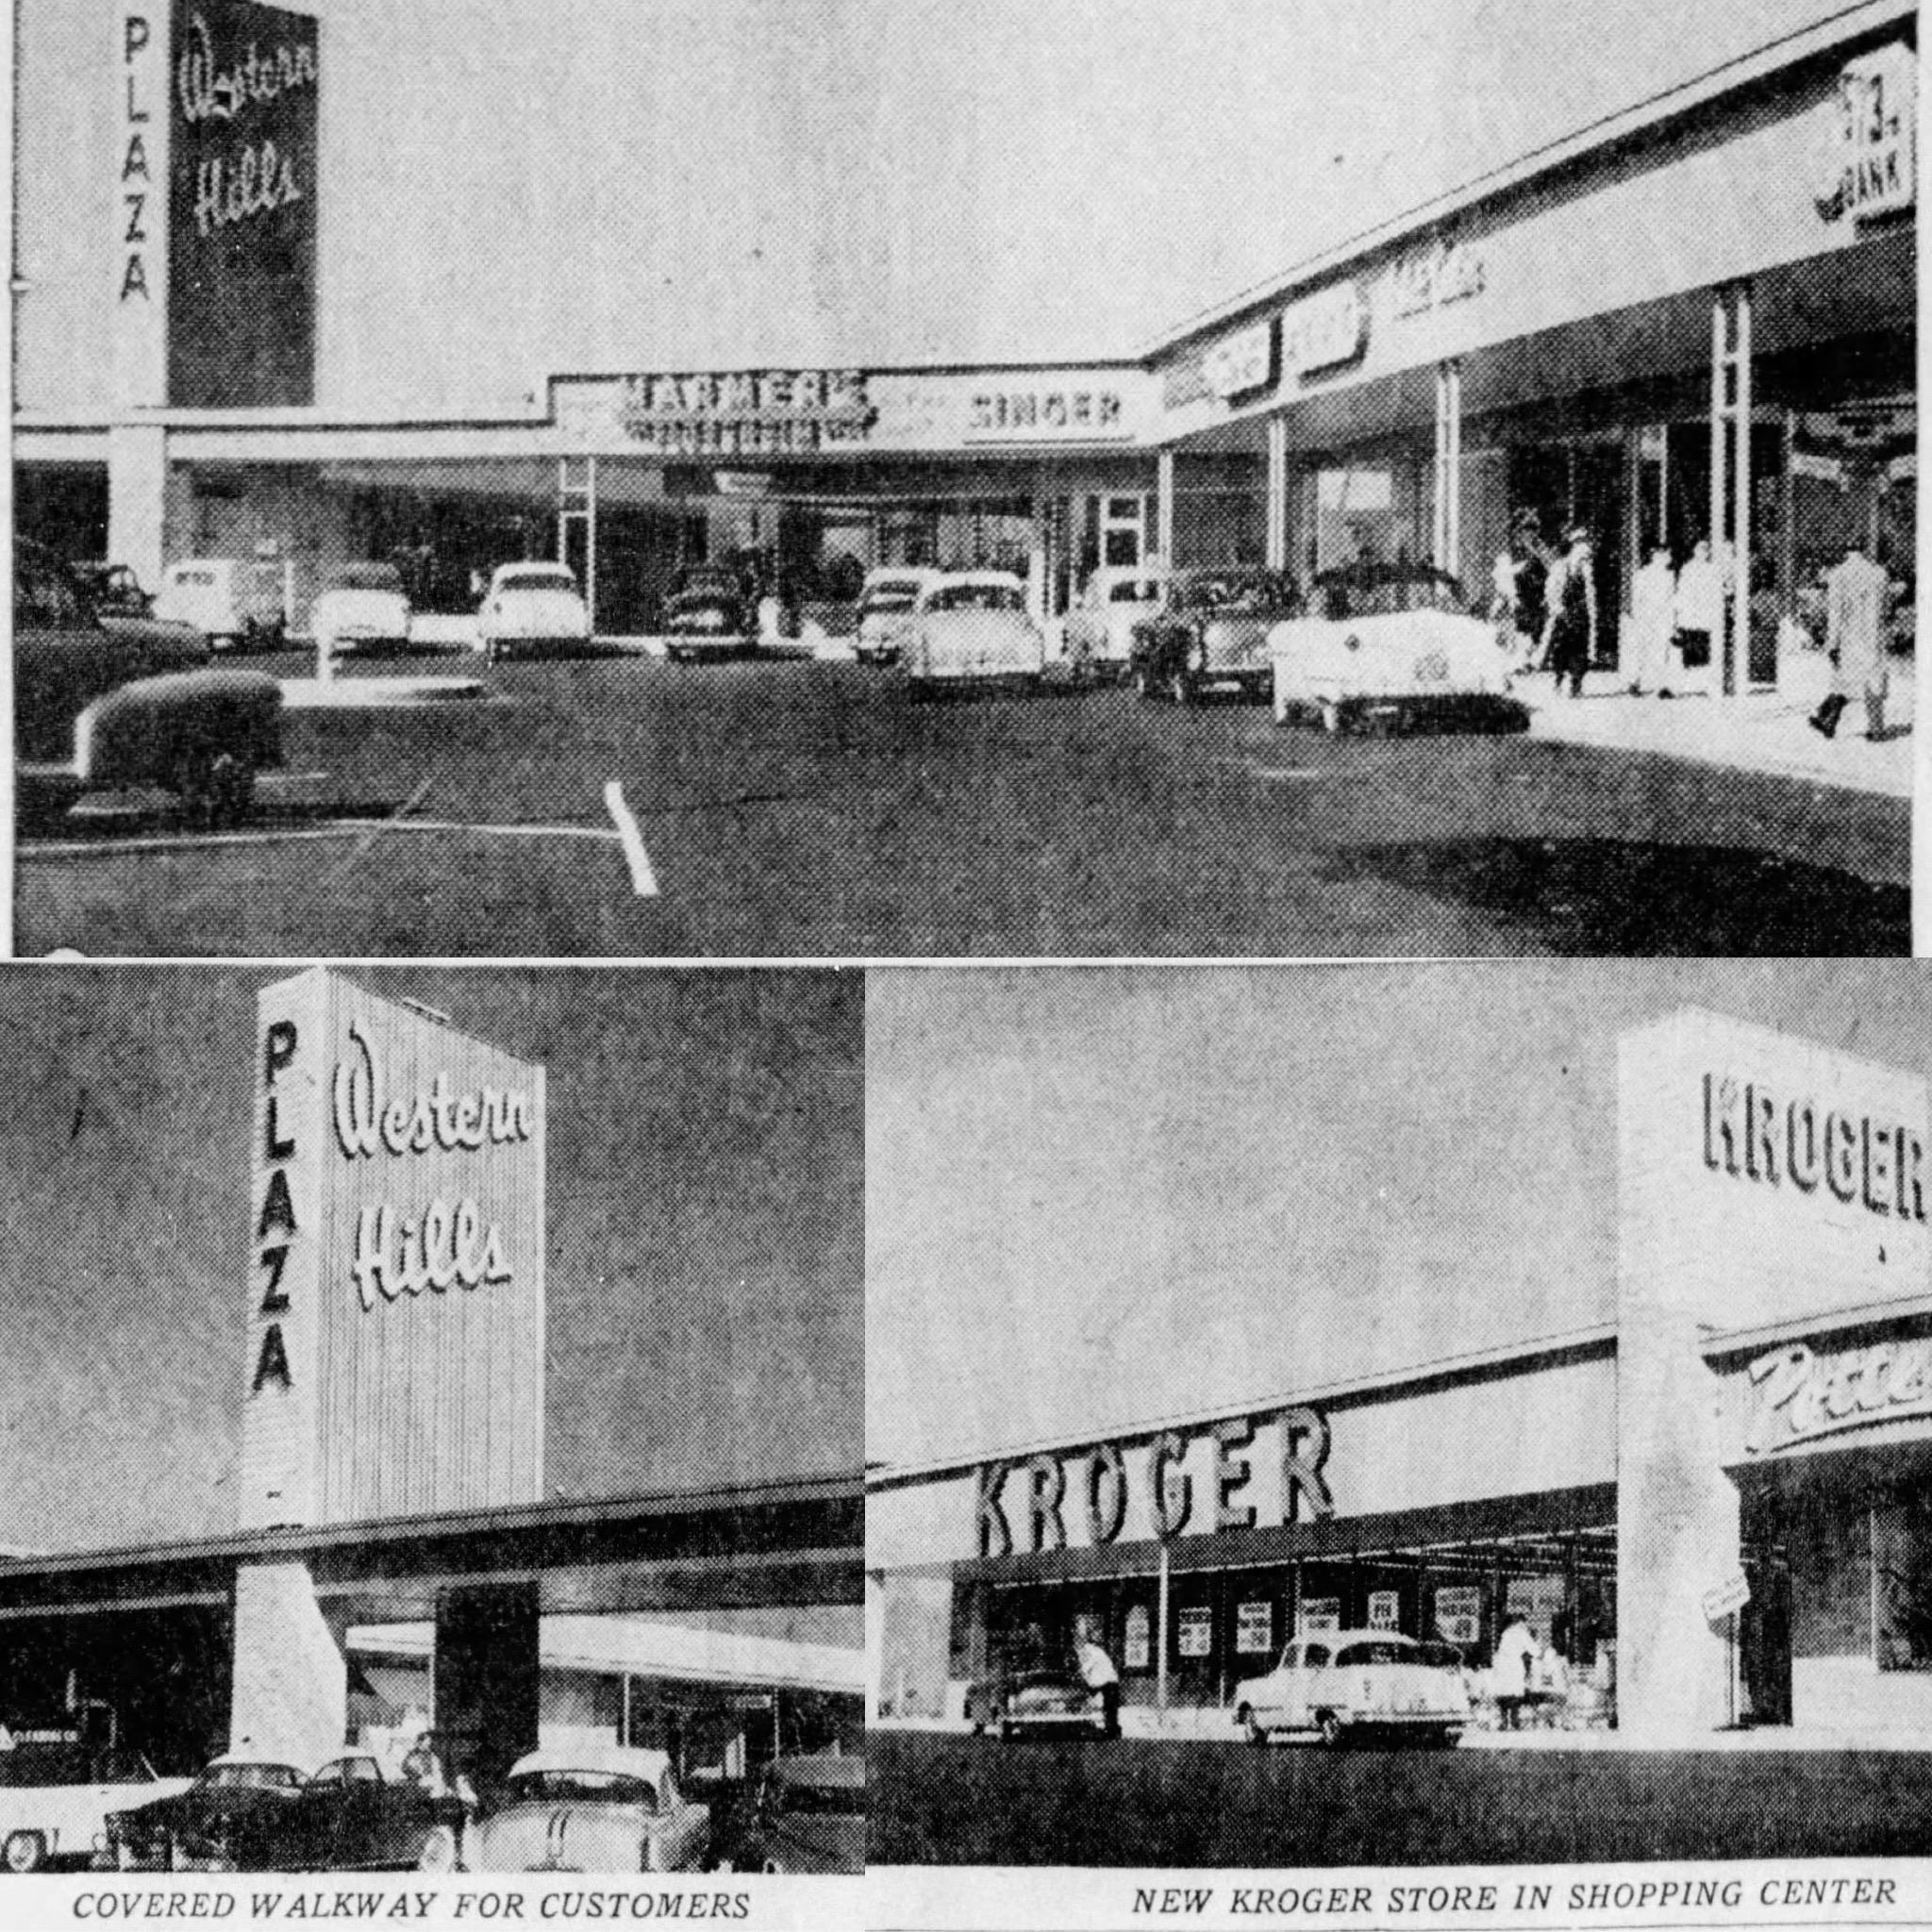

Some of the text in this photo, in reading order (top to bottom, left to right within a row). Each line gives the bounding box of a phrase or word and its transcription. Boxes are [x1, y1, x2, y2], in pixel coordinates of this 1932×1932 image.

[179, 10, 317, 122] Western
[122, 16, 151, 302] PLAZA
[193, 140, 301, 236] Hills
[968, 391, 1122, 428] SINGER
[332, 1021, 529, 1161] Western
[1702, 1072, 1928, 1225] KROGER
[252, 1020, 298, 1394] PLAZA
[351, 1198, 512, 1313] Hills
[975, 1407, 1336, 1558] KROGER
